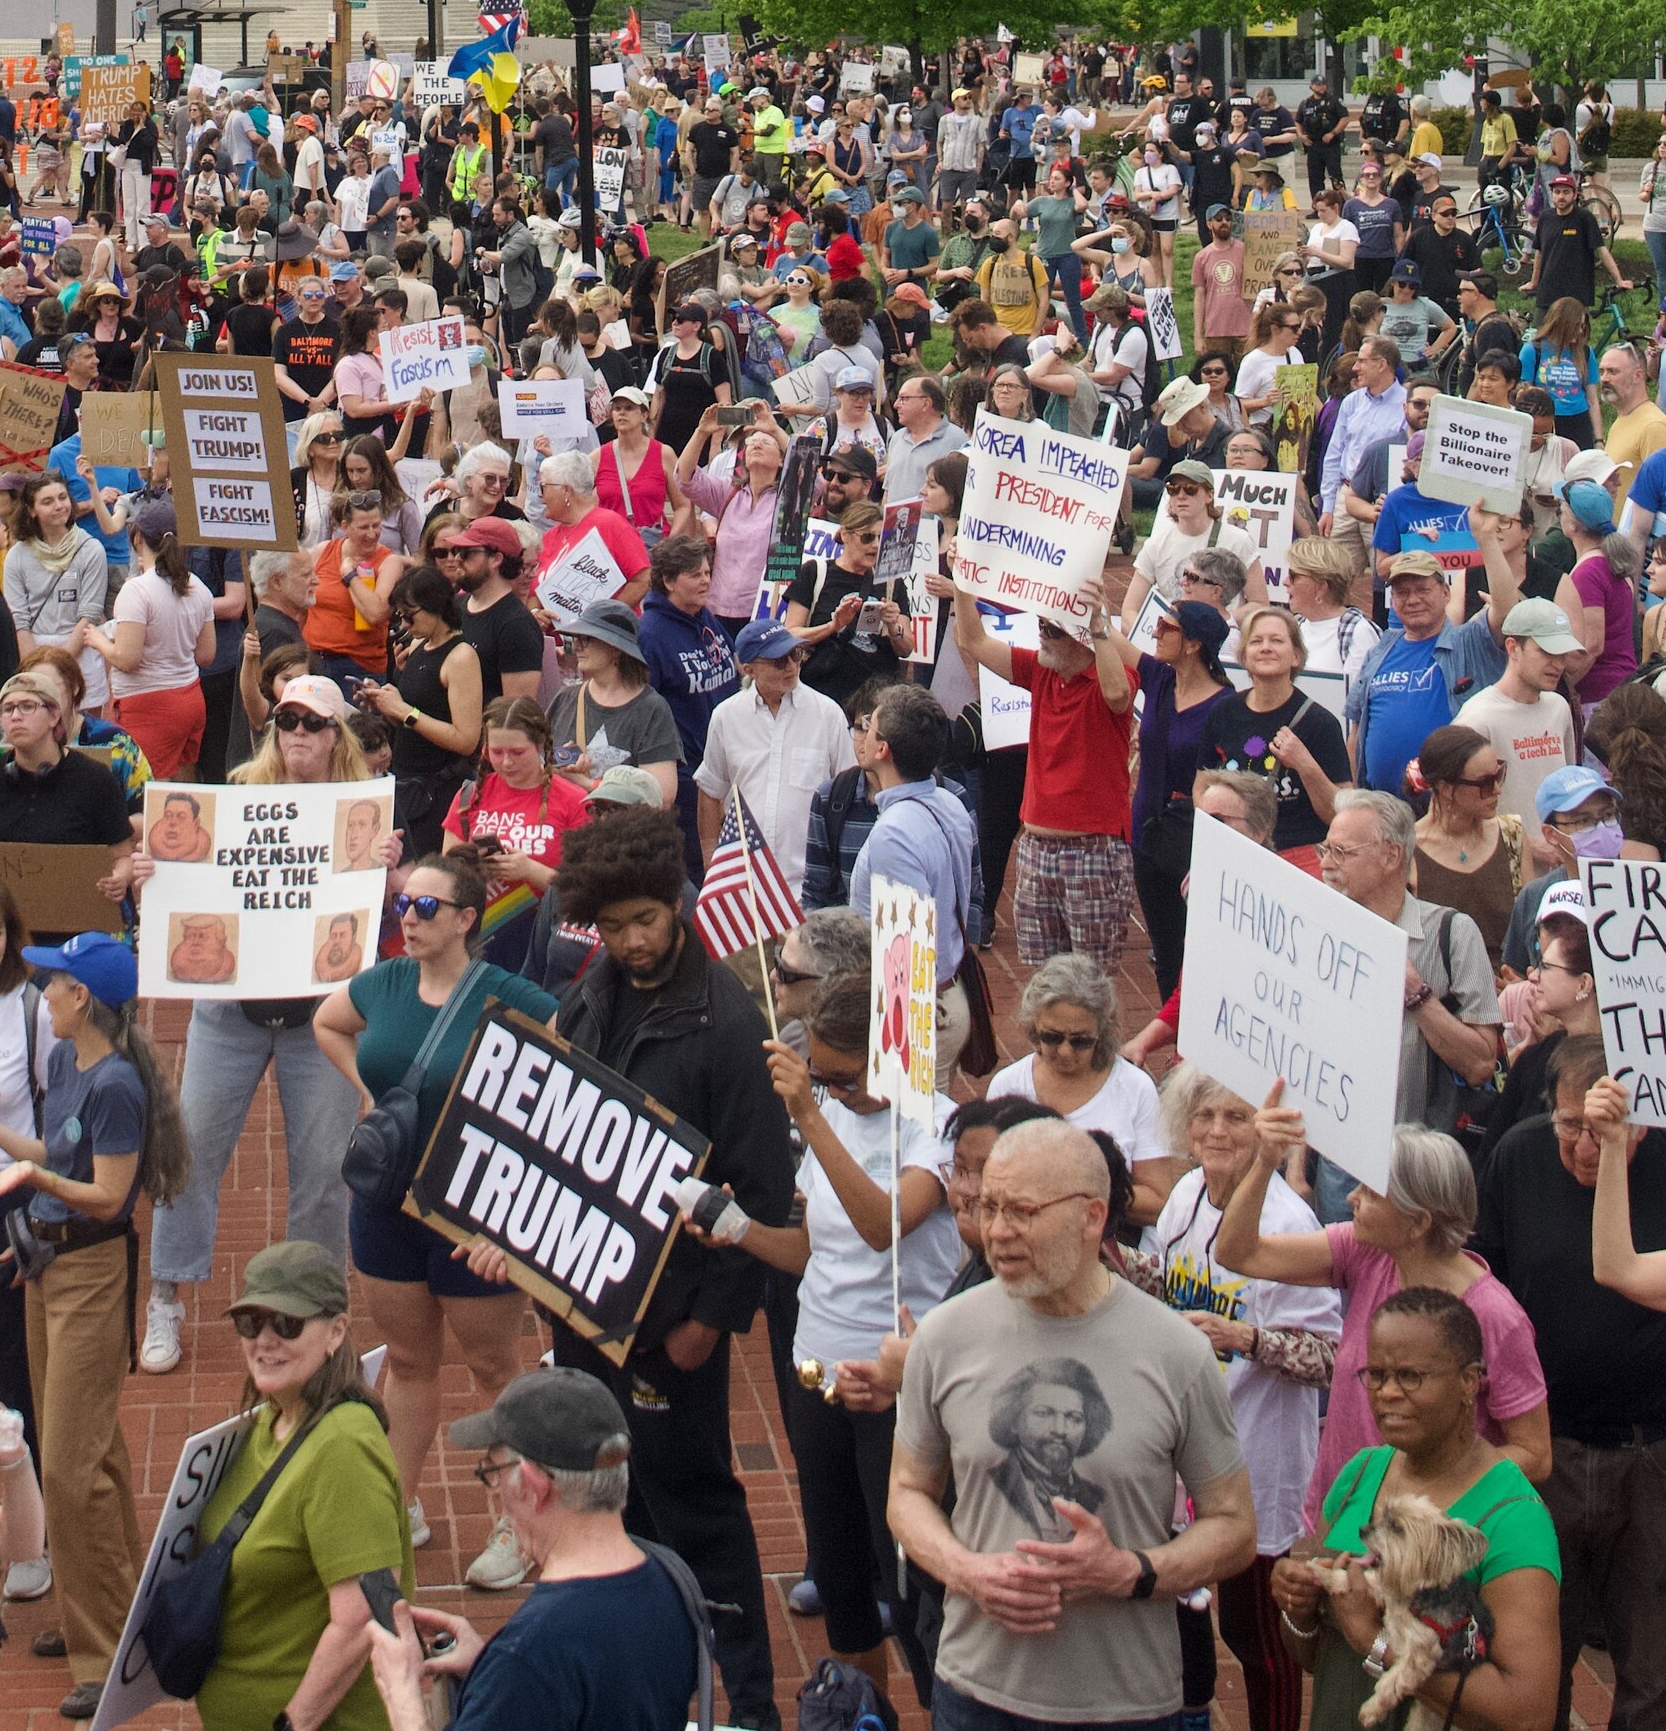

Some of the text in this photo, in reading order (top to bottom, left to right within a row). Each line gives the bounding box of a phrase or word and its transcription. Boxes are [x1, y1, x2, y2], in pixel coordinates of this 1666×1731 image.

[88, 65, 141, 84] TRUMP
[416, 64, 436, 75] WE
[423, 78, 449, 88] THE
[87, 86, 137, 104] HATES
[415, 93, 463, 104] PEOPLE
[290, 336, 334, 348] BALTIMORE
[390, 319, 436, 356] Resist
[183, 373, 254, 392] JOIN US!
[390, 355, 454, 390] Fascism
[199, 415, 247, 432] FIGHT
[1448, 421, 1508, 445] Stop the
[193, 439, 261, 458] TRUMP!
[973, 419, 1119, 488] KOREA IMPEACHED
[1440, 436, 1511, 462] Billionaire
[1439, 451, 1509, 476] Takeover!
[209, 484, 254, 500] FIGHT
[995, 470, 1085, 525] PRESIDENT
[200, 506, 271, 524] FASCISM!
[963, 514, 1066, 566] UNDERMINING
[998, 571, 1088, 616] INSTITUTIONS
[242, 803, 299, 824] EGGS
[476, 810, 526, 827] BANS
[247, 824, 290, 846] ARE
[217, 844, 330, 867] EXPENSIVE
[232, 865, 319, 889] EAT THE
[244, 890, 312, 911] REICH
[1219, 871, 1375, 999] HANDS OFF
[1255, 971, 1302, 1025] OUR
[1215, 996, 1353, 1122] AGENCIES
[460, 1018, 693, 1231] REMOVE
[444, 1126, 636, 1306] TRUMP
